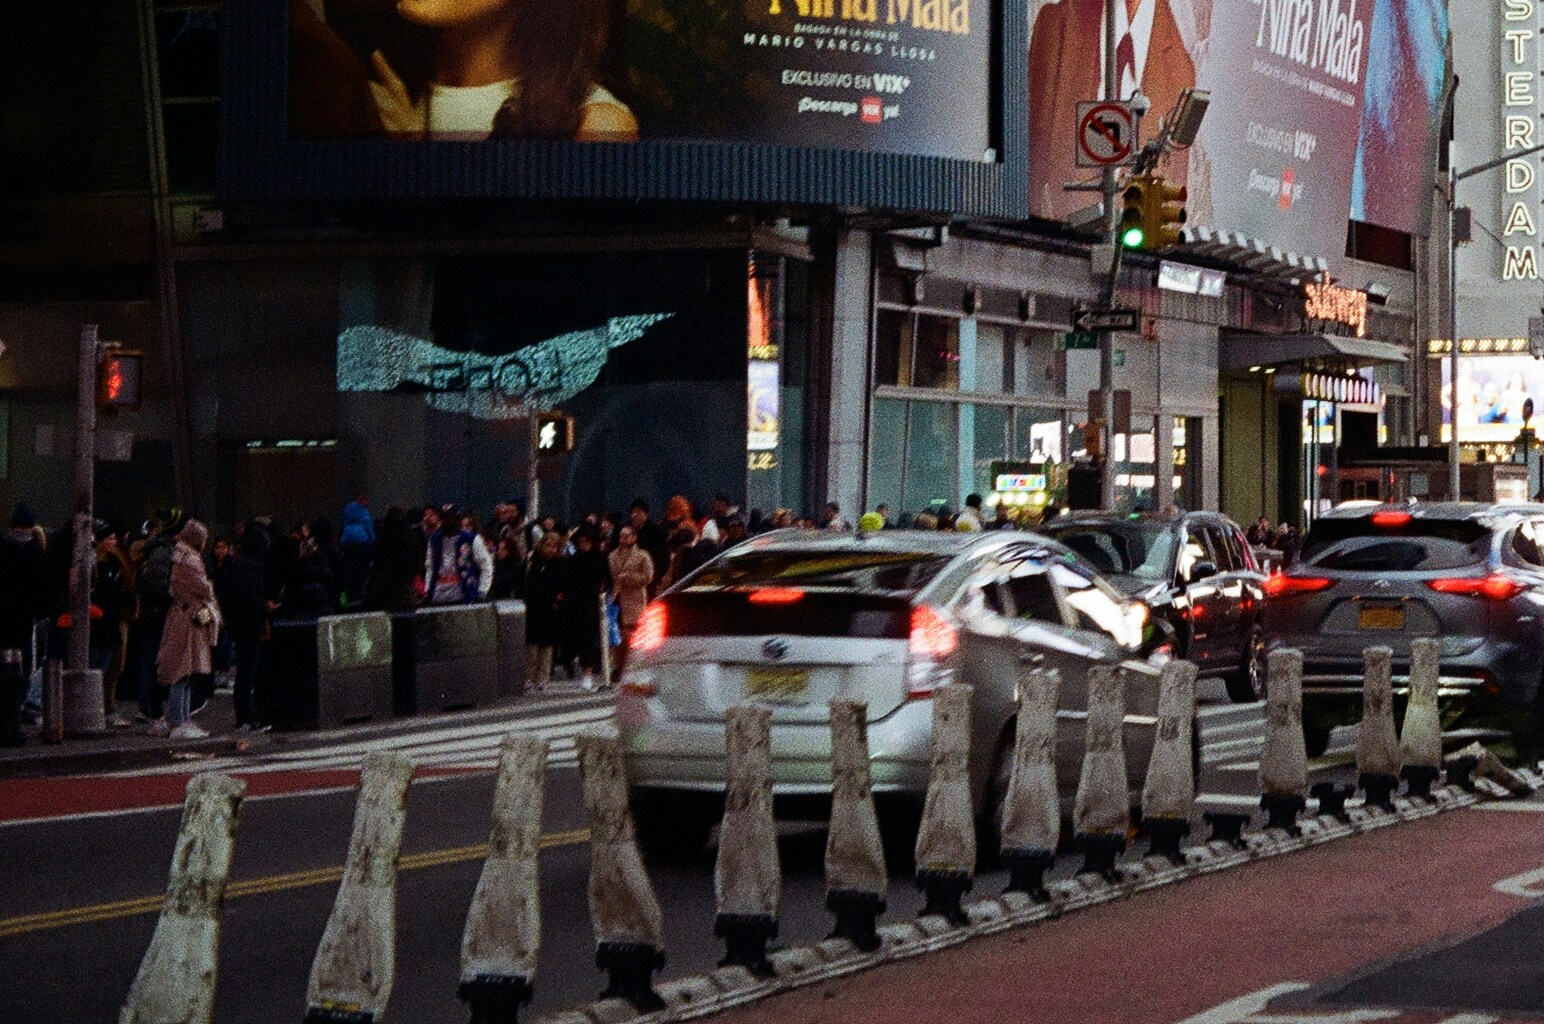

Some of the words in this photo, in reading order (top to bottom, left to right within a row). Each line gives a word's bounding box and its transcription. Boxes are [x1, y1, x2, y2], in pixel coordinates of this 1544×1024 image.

[743, 32, 805, 49] MARIO
[815, 37, 884, 55] VARGAS
[890, 46, 937, 62] LLOSA
[781, 68, 852, 89] EXCLUSIVO
[854, 74, 872, 90] EN
